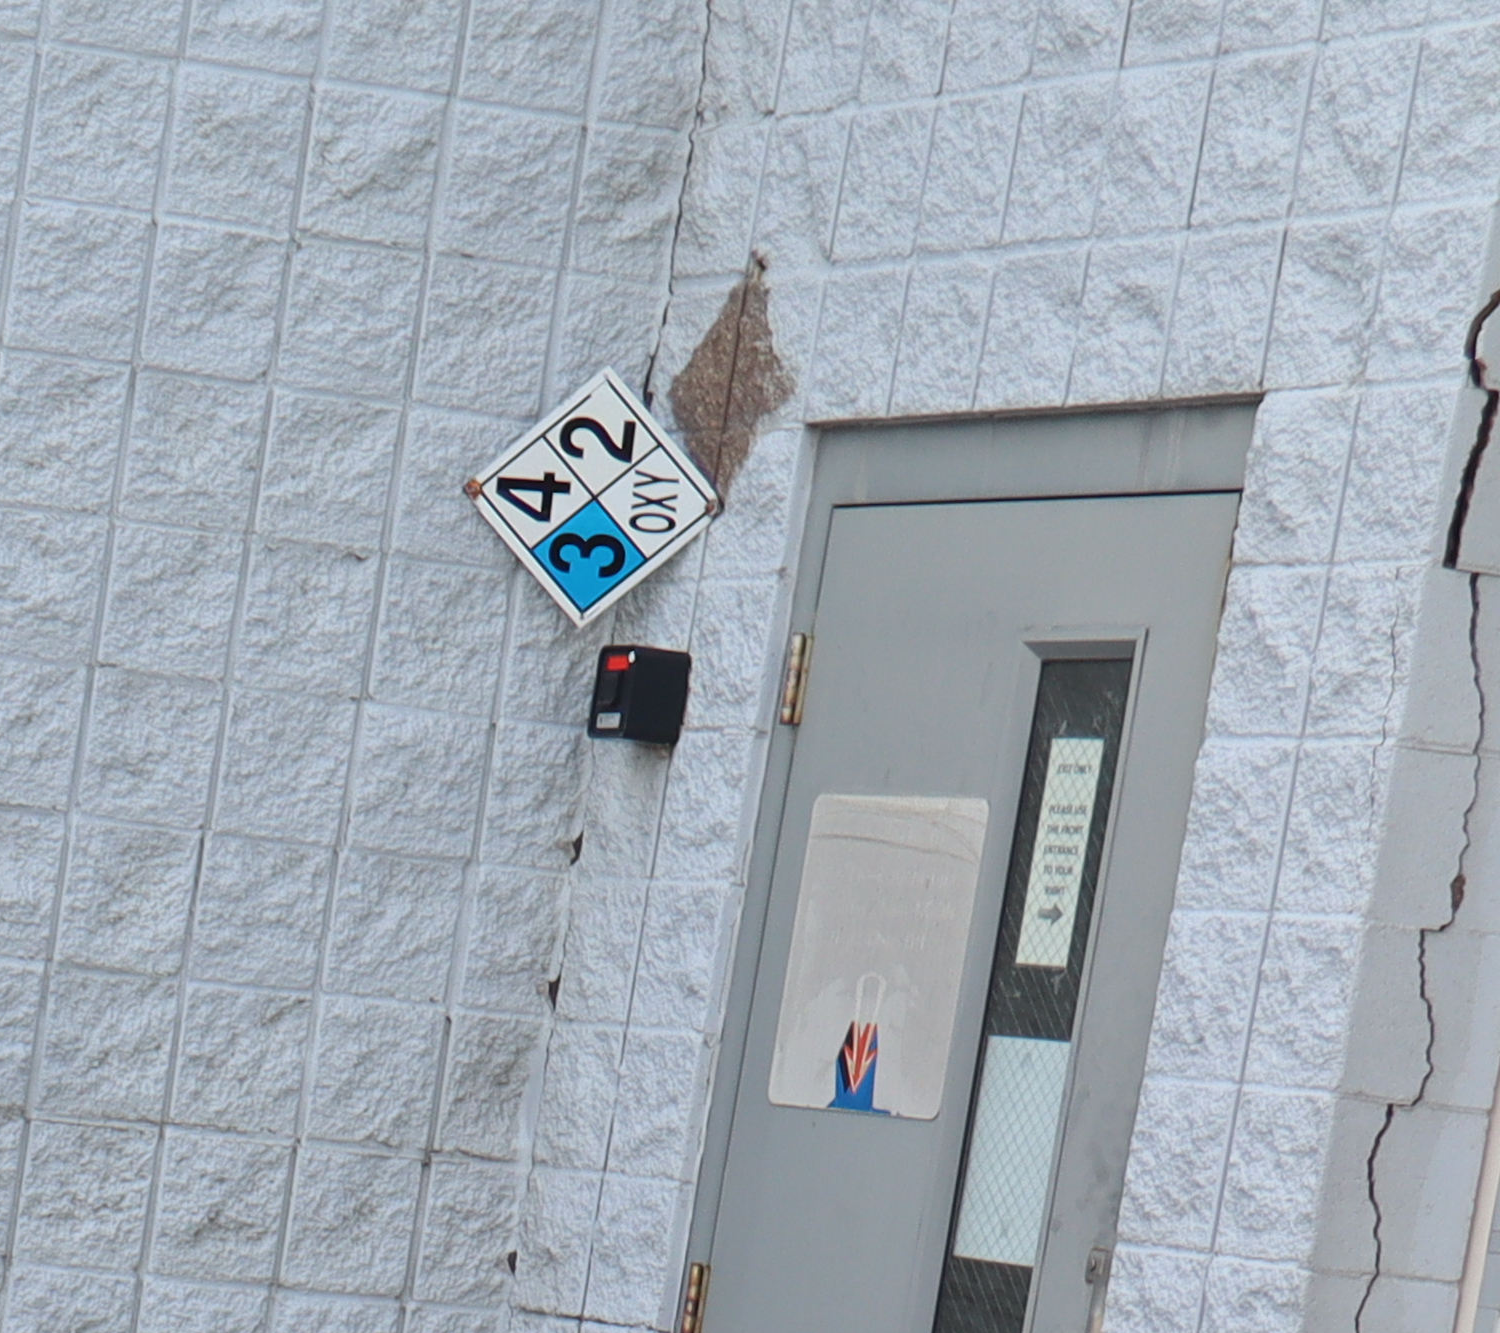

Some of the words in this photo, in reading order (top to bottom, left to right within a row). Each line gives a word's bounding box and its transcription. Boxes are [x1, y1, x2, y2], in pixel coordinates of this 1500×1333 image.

[559, 416, 637, 463] 2
[496, 472, 572, 522] 4
[629, 470, 680, 534] OXY
[549, 532, 626, 578] 3
